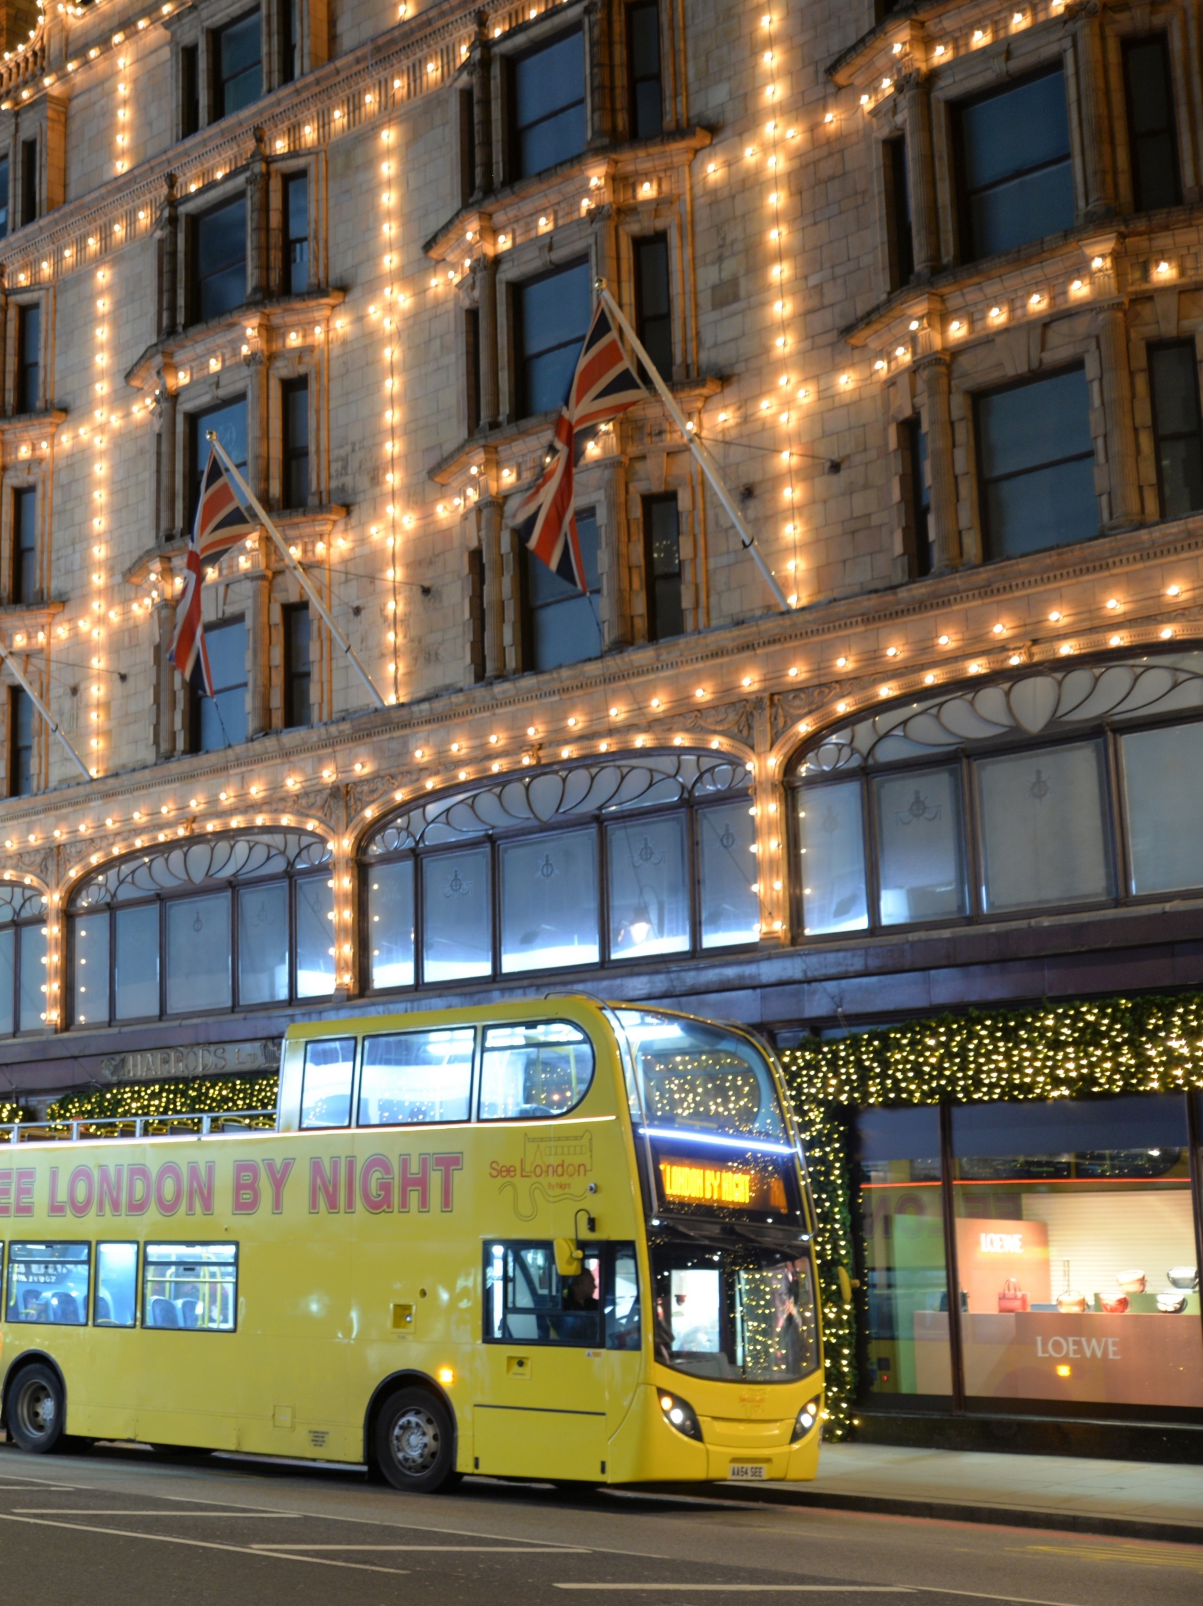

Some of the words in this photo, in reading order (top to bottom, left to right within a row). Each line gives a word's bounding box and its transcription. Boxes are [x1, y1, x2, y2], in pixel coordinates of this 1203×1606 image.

[126, 1047, 227, 1077] HARRODS
[489, 1160, 517, 1178] See
[520, 1158, 587, 1178] London
[48, 1161, 216, 1218] LONDON
[232, 1157, 296, 1215] BY
[308, 1151, 464, 1215] NIGHT
[980, 1233, 1024, 1253] LOEWE
[1036, 1336, 1121, 1359] LOEWE
[731, 1466, 748, 1477] AA54
[750, 1466, 763, 1477] SEE
